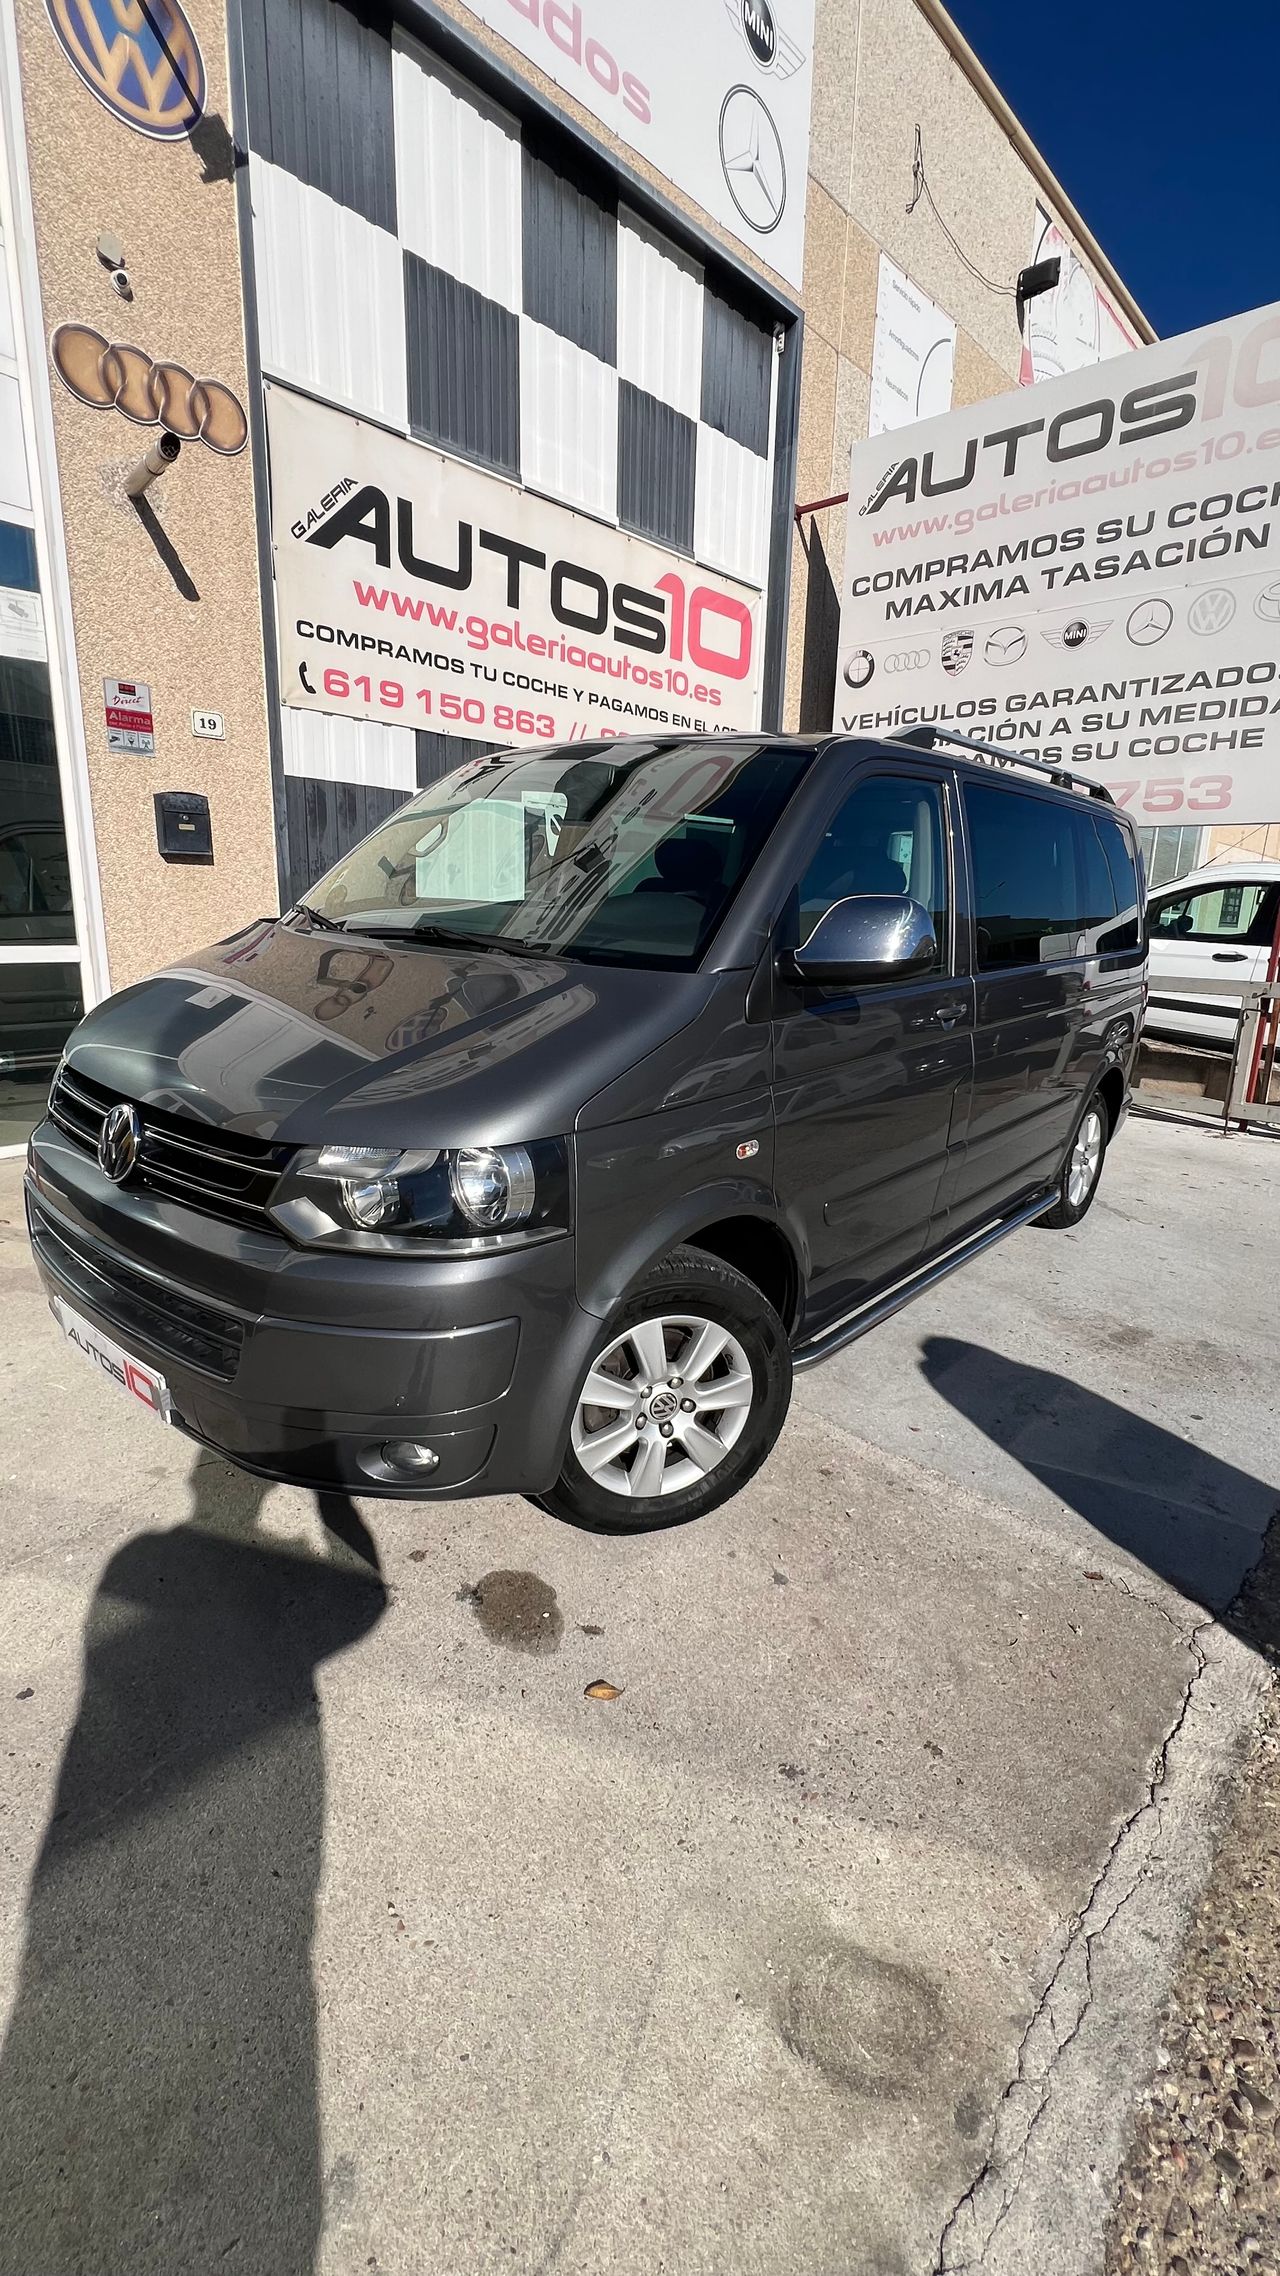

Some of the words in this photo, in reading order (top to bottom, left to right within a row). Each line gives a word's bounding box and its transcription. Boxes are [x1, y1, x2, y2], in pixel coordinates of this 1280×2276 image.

[743, 7, 775, 51] MINI
[290, 477, 359, 539] GALERIA
[857, 461, 900, 517] GALERIA
[852, 527, 1086, 598] COMPRAMOS
[1096, 509, 1156, 546] SU
[885, 574, 1031, 621] MAXIMA
[1040, 522, 1271, 591] TASACIÓN
[352, 580, 722, 706] www.galeriaautos10.es
[1064, 628, 1088, 641] MINI
[296, 619, 466, 675] COMPRAMOS
[470, 663, 498, 682] TU
[502, 671, 569, 700] COCHE
[572, 687, 585, 703] Y
[588, 691, 669, 724] PAGAMOS
[672, 713, 692, 730] EN
[694, 718, 708, 733] EL
[323, 668, 404, 709] 619
[416, 688, 485, 726] 150
[493, 704, 556, 739] 863
[841, 697, 998, 732] VEHÍCULOS
[1005, 661, 1280, 713] GARANTIZADO
[109, 710, 151, 726] Alarma
[200, 717, 217, 731] 19
[1050, 717, 1072, 736] A
[1081, 709, 1131, 734] SU
[1071, 740, 1119, 763] SU
[1128, 727, 1266, 758] COCHE
